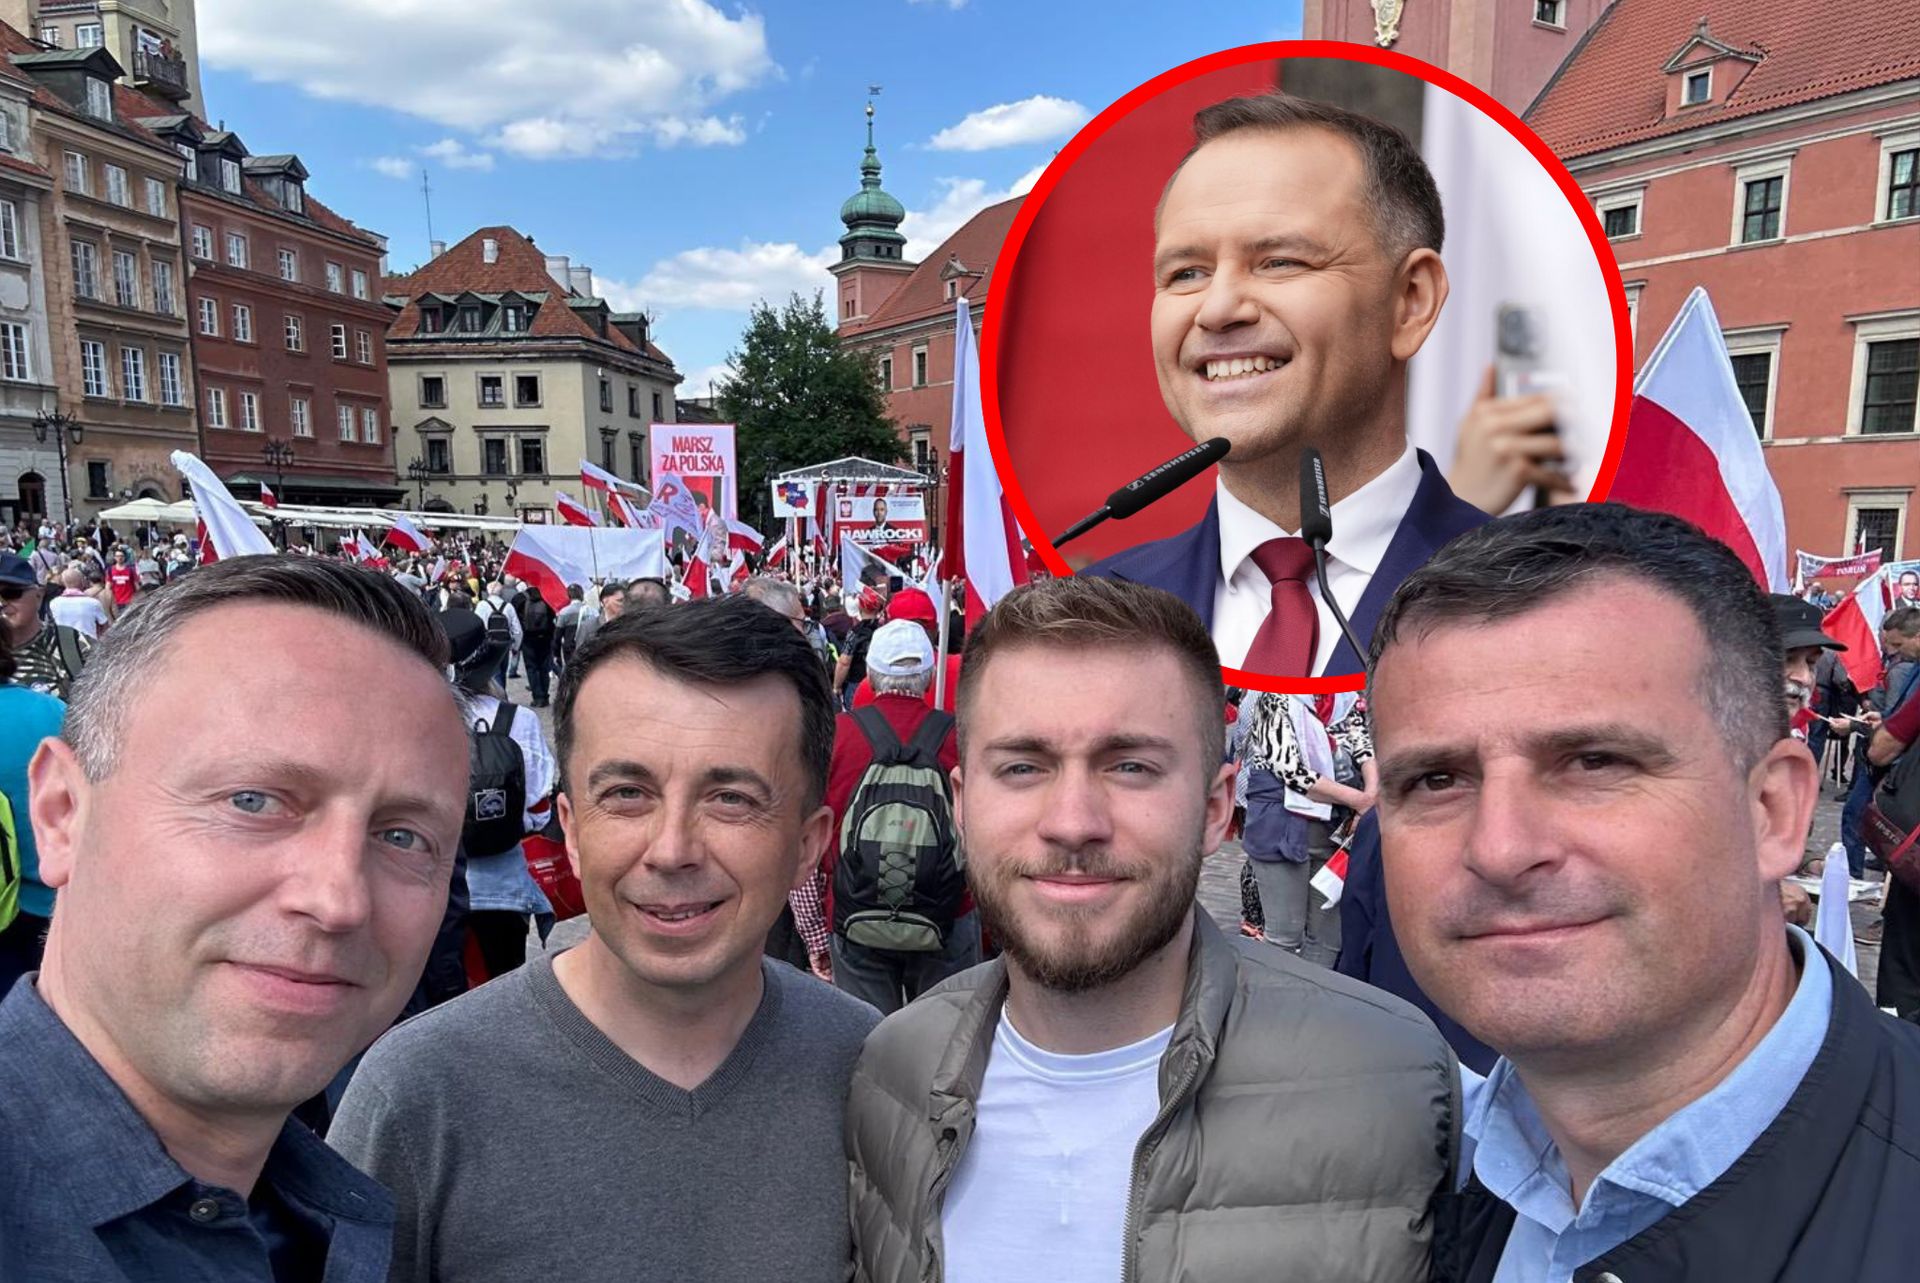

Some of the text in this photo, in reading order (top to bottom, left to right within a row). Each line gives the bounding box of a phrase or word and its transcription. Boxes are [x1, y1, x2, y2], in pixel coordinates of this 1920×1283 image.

[672, 436, 714, 453] MARSZ
[661, 454, 725, 475] ZA POLSKĄ
[1143, 443, 1210, 481] SENNHEISER
[840, 528, 923, 540] NAWROCKI
